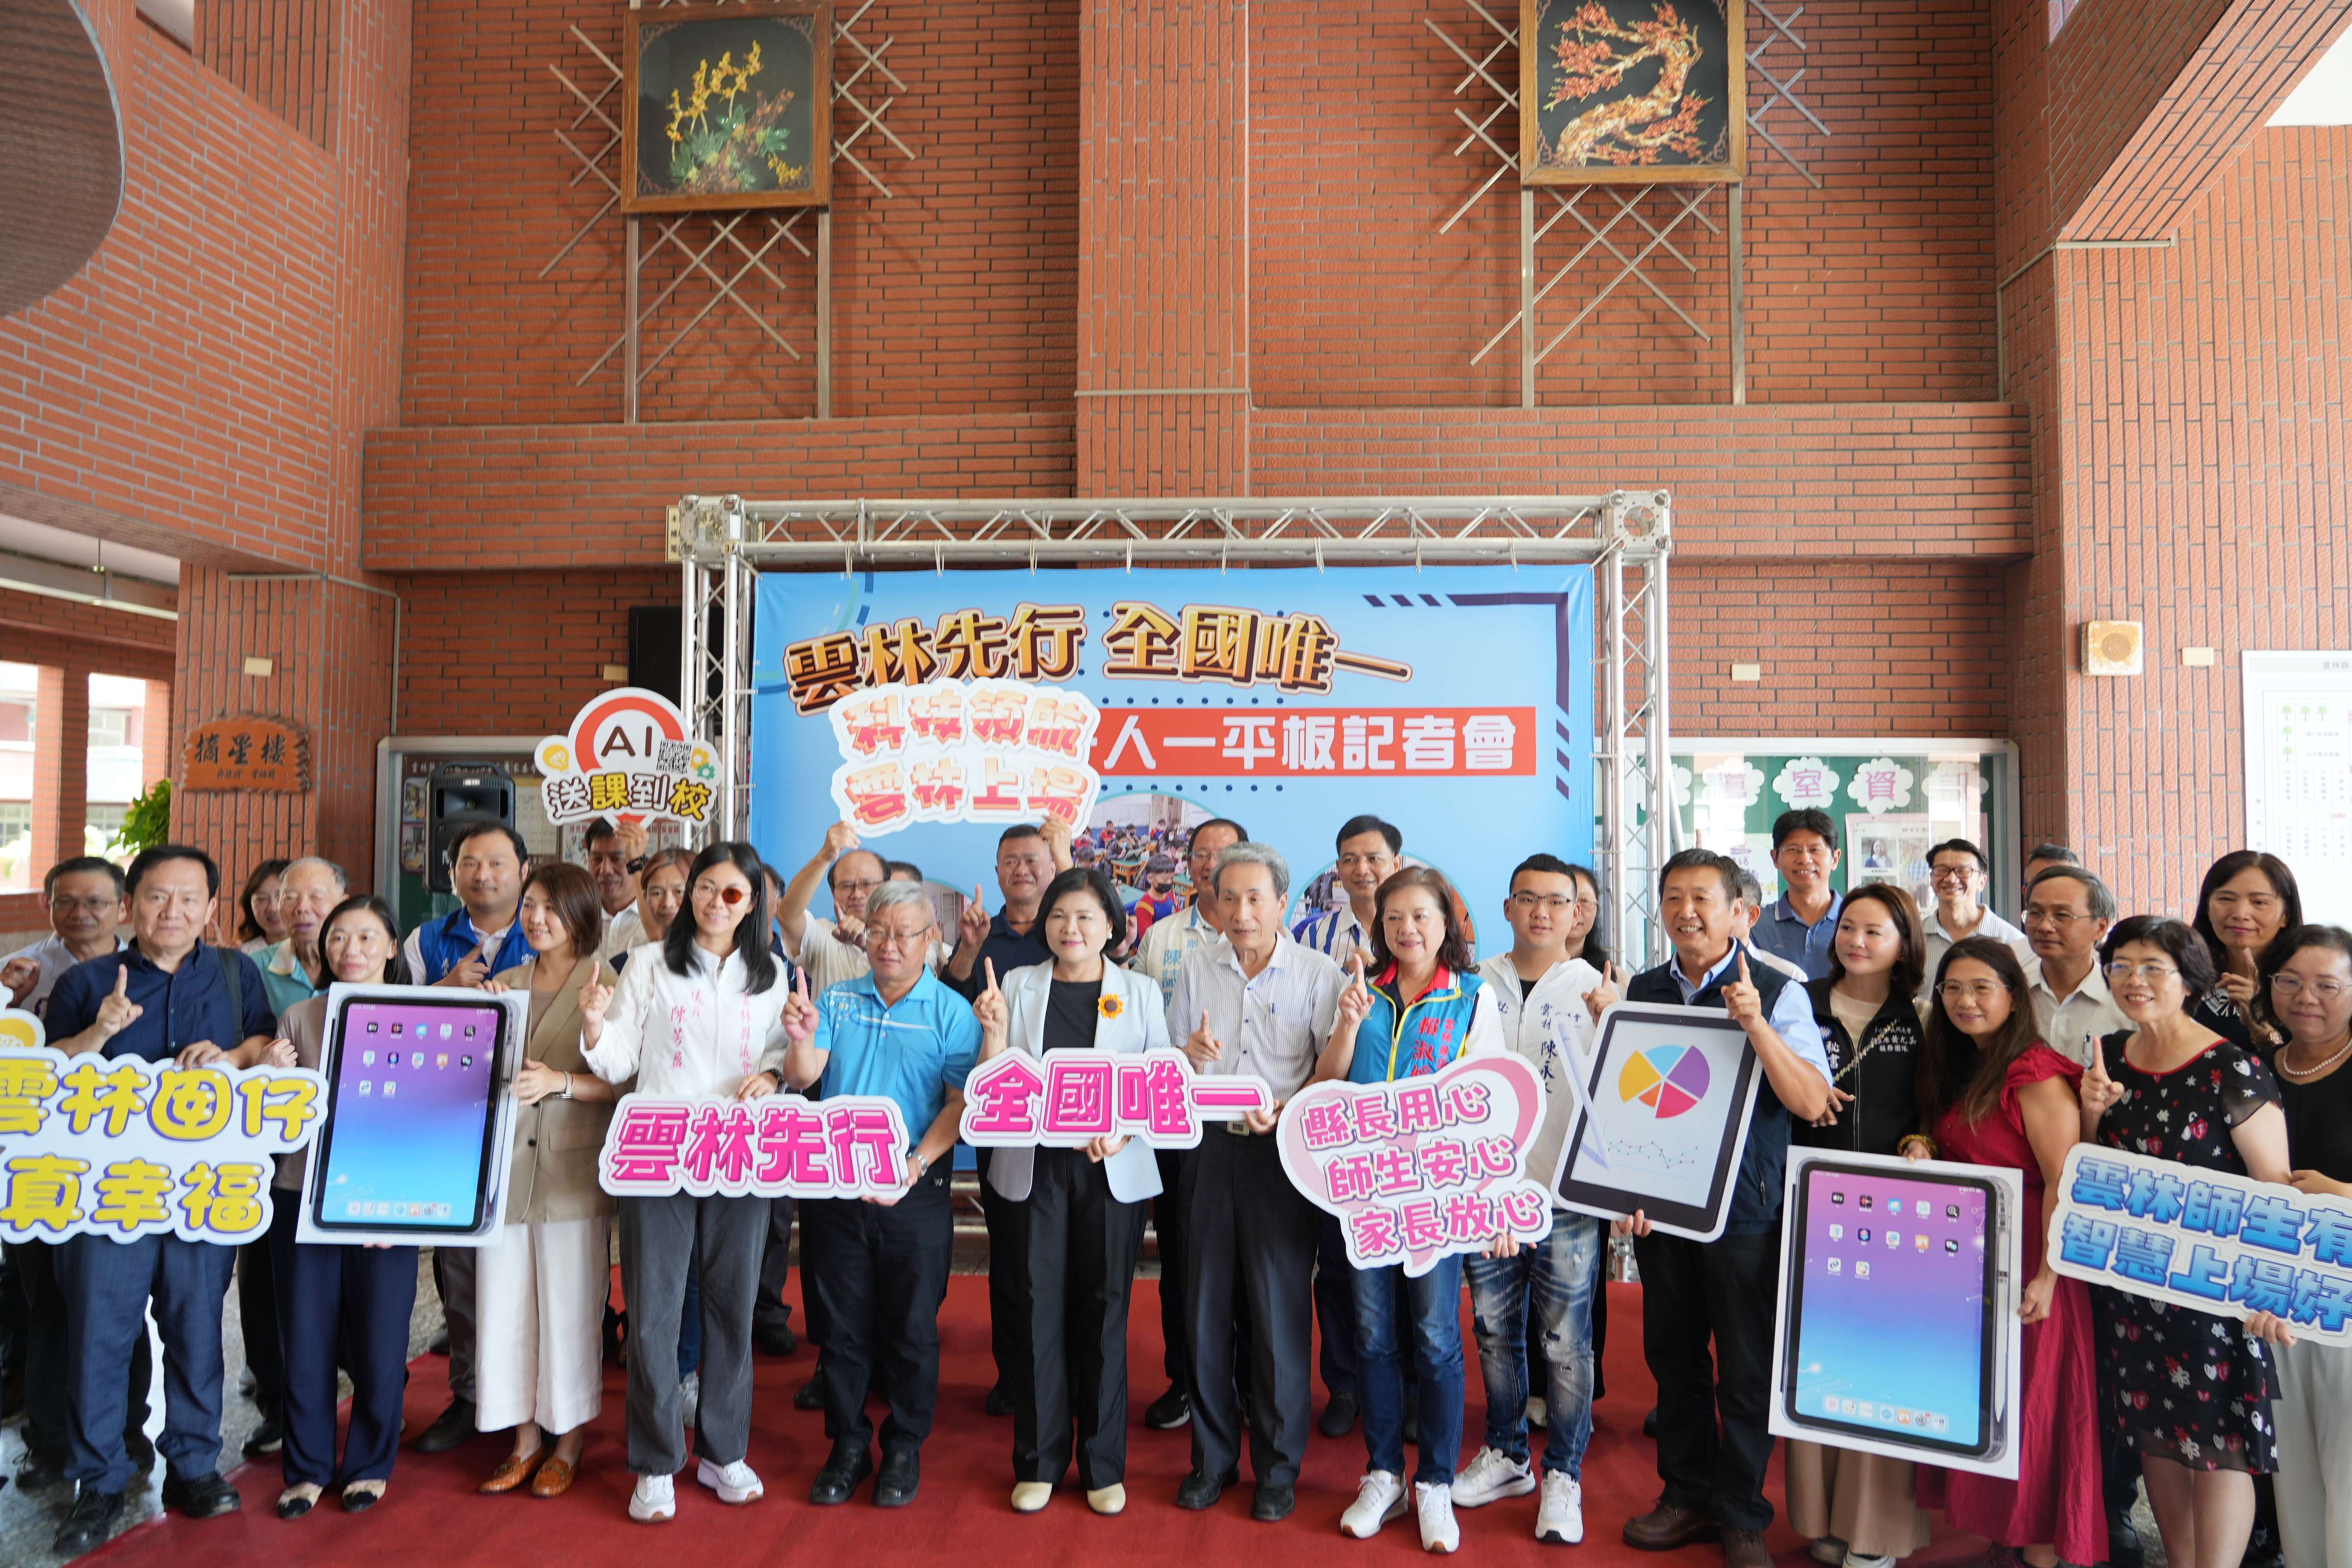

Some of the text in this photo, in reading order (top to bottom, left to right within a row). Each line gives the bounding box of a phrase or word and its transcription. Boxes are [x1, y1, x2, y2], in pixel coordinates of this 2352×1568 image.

[786, 601, 1412, 716] 雲林先行 全國唯一
[195, 732, 286, 767] 摘星樓
[601, 726, 651, 757] AI
[844, 690, 1088, 756] 科技領航
[1092, 715, 1516, 770] 人一平板記者會
[548, 774, 711, 821] 送課到校
[845, 757, 1089, 825] 雲林上場
[970, 1060, 1262, 1134] 全國唯一
[1302, 1082, 1490, 1150] 縣長用心
[611, 1107, 897, 1184] 雲林先行
[1325, 1136, 1516, 1204] 師生安心
[0, 1154, 264, 1233] 真幸福
[1350, 1188, 1544, 1259] 家長放心
[2060, 1211, 2352, 1333] 智慧上場好
